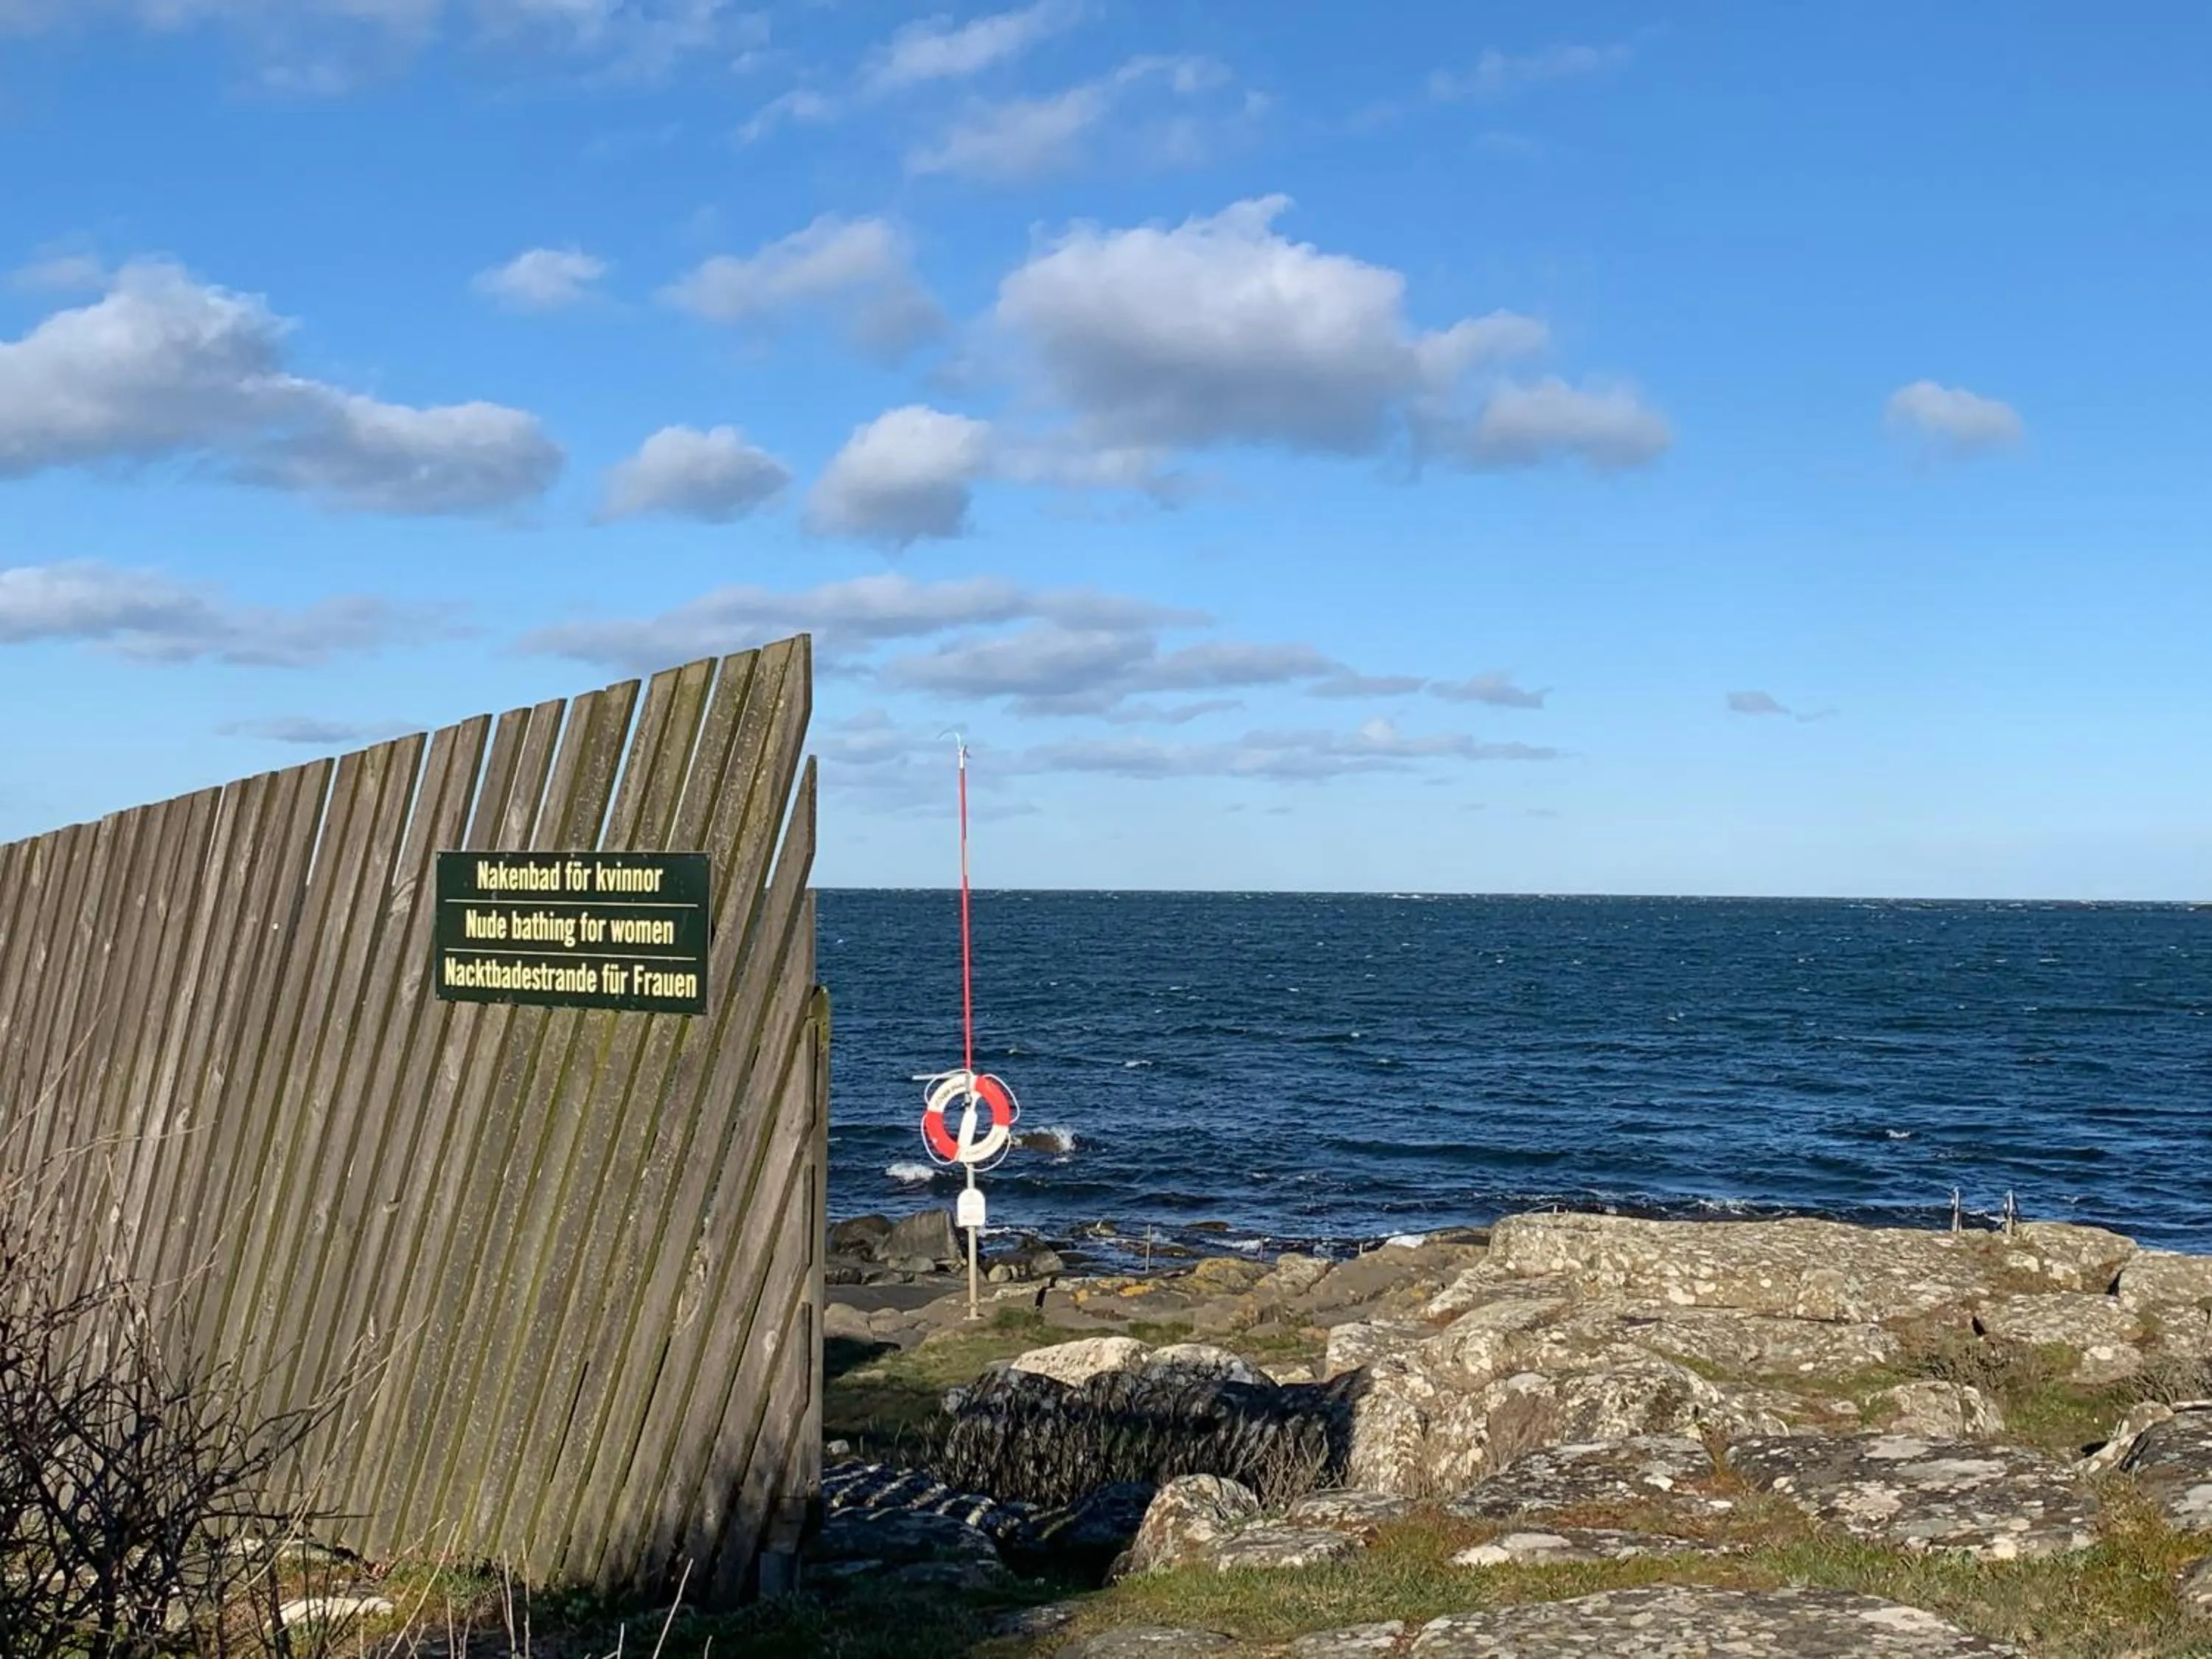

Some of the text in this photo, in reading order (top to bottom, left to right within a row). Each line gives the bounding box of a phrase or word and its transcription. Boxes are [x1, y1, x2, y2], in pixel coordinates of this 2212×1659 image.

[477, 860, 664, 892] Nakenbad för kvinnor
[465, 909, 674, 948] Nude bathing for women
[445, 956, 697, 998] Nacktbadestrande für Frauen
